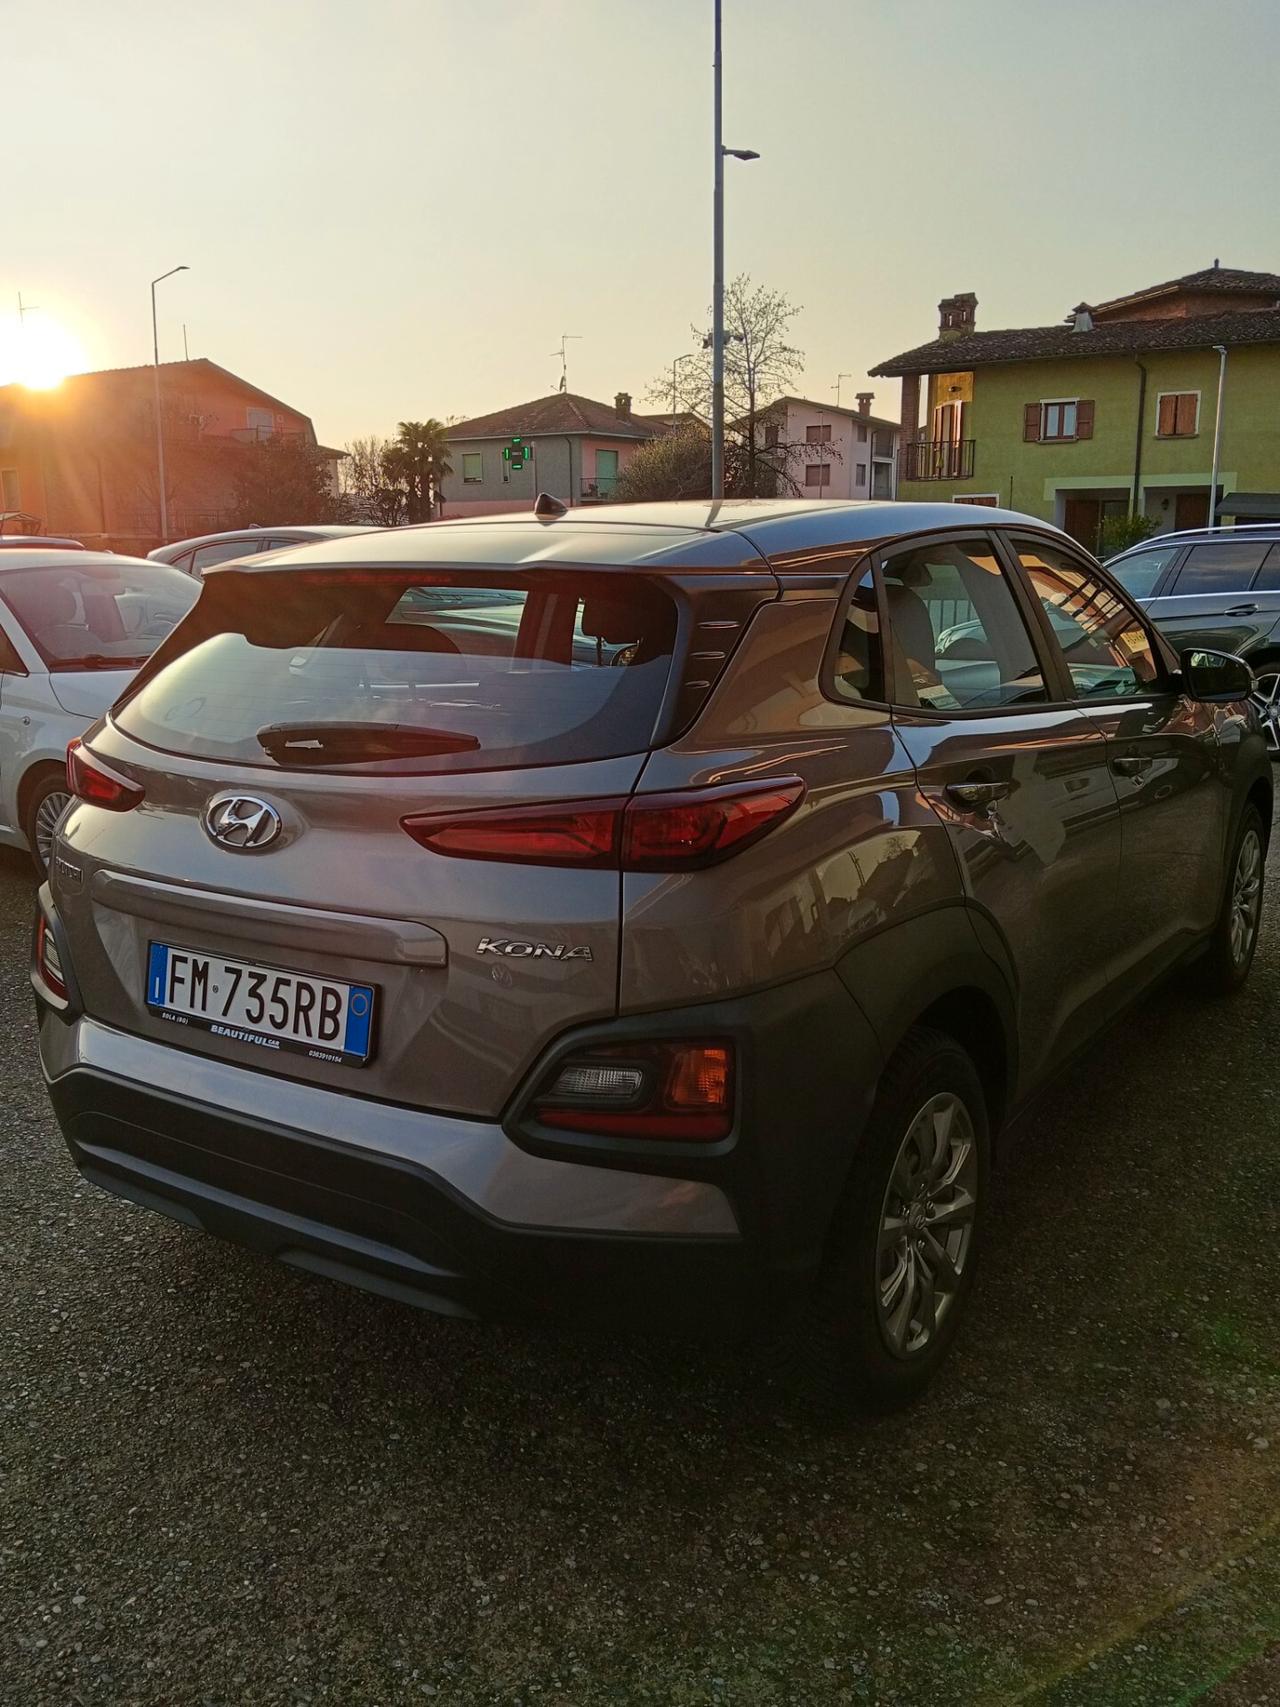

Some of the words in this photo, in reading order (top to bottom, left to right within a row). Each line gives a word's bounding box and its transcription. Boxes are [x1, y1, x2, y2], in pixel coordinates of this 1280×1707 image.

[477, 938, 592, 961] KONA
[169, 954, 210, 1011] FM
[222, 966, 342, 1041] 735RB
[210, 1024, 269, 1046] BEAUTIFUL
